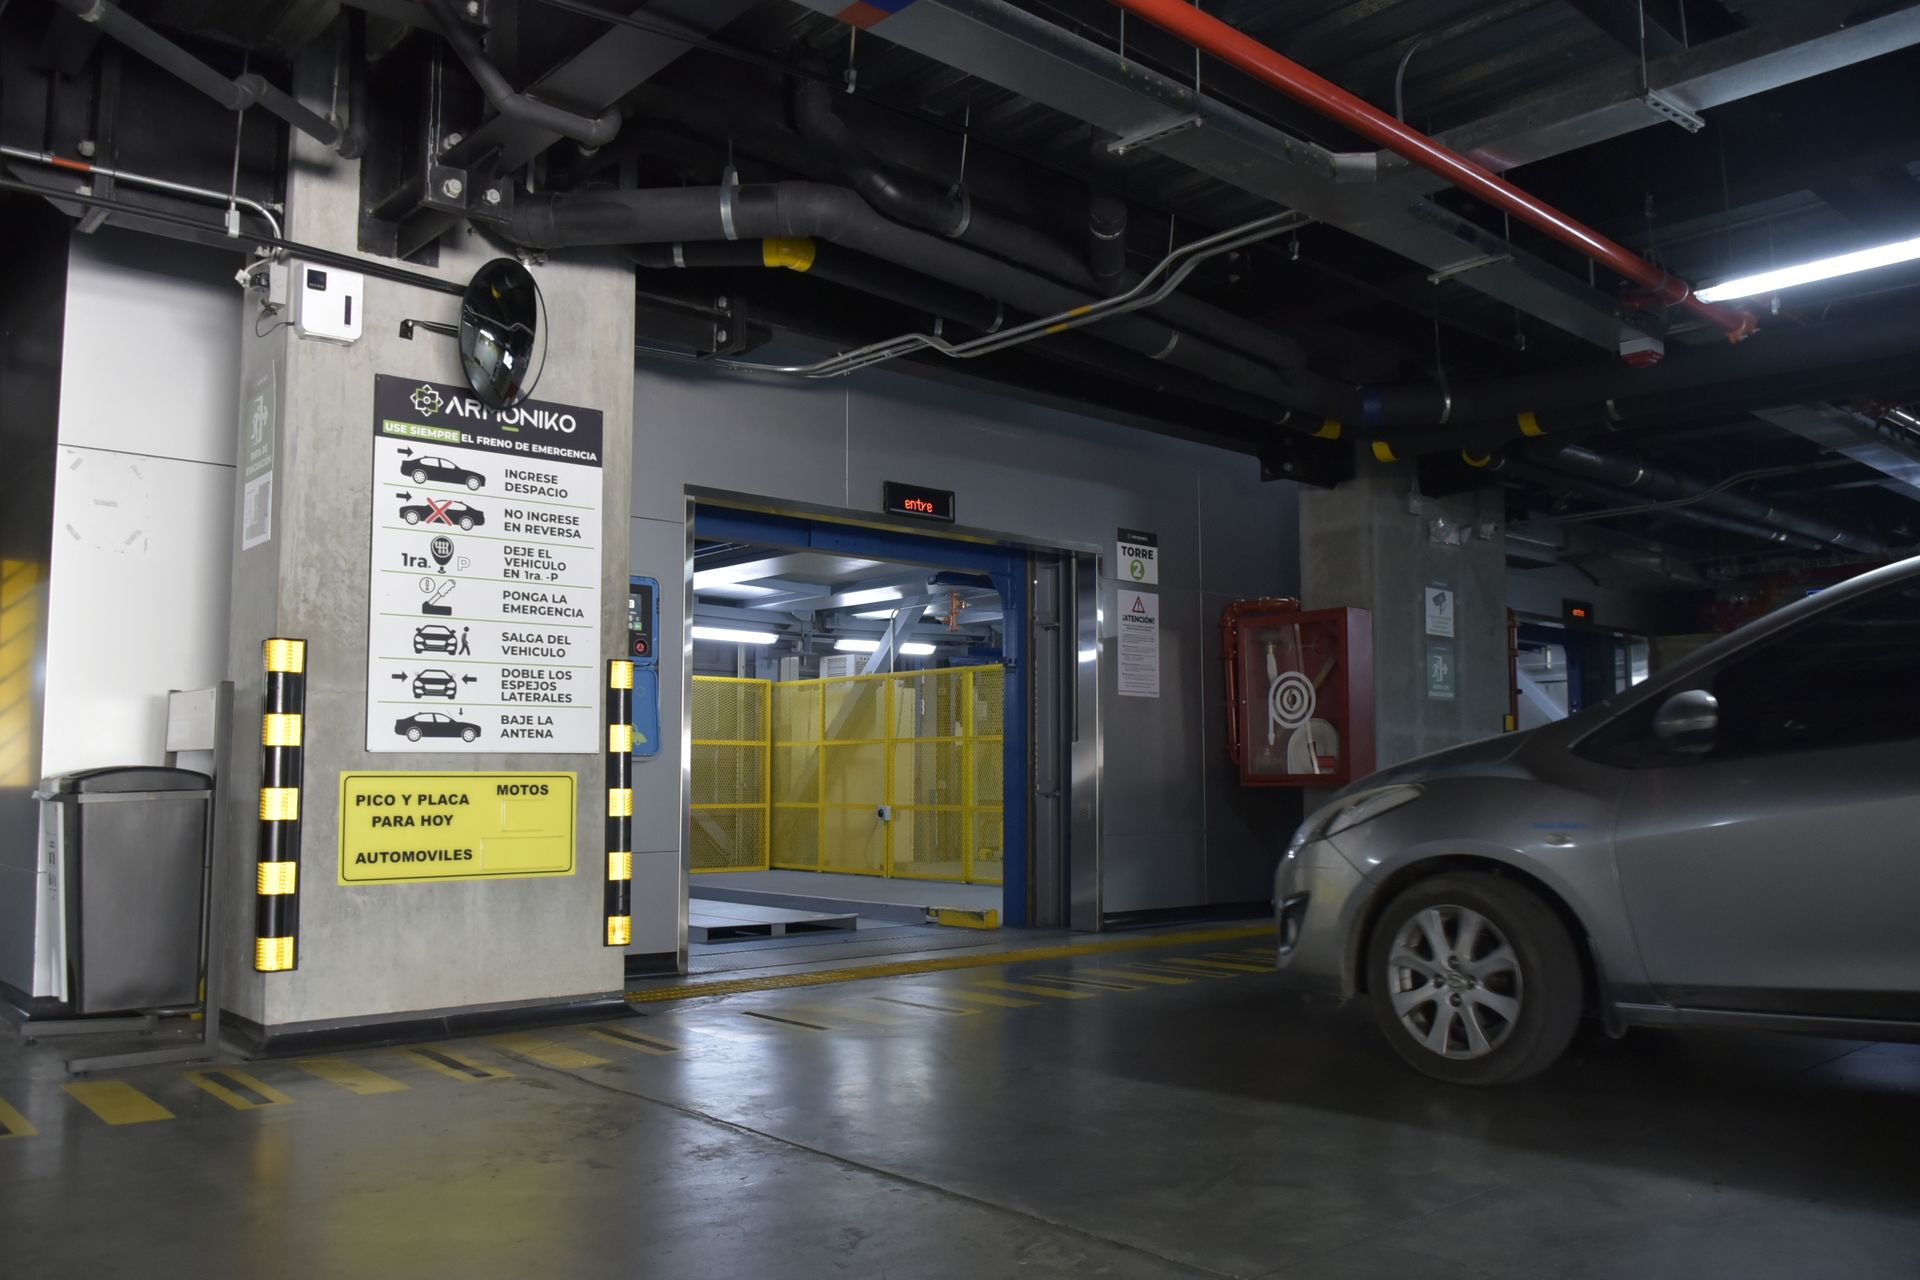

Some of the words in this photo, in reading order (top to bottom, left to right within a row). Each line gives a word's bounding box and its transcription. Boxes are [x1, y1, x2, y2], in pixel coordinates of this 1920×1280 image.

[385, 423, 407, 433] USE
[410, 427, 458, 441] SIEMPRE
[462, 434, 474, 443] EL
[476, 436, 512, 448] FRENO
[515, 442, 529, 451] DE
[531, 444, 597, 461] EMERGENCIA
[505, 469, 558, 484] INGRESE
[504, 483, 568, 498] DESPACIO
[904, 499, 933, 512] entre
[504, 509, 523, 520] NO
[527, 511, 580, 526] INGRESE
[504, 522, 522, 532] EN
[525, 524, 581, 539] REVERSA
[504, 546, 534, 557] DEJE
[538, 548, 552, 558] EL
[1121, 546, 1154, 560] TORRE
[402, 553, 431, 569] 1ra.
[457, 557, 470, 571] P
[504, 557, 566, 571] VEHICULO
[504, 569, 520, 579] EN
[524, 570, 543, 581] 1ra.
[503, 590, 549, 603] PONGA
[552, 594, 567, 604] LA
[503, 604, 584, 618] EMERGENCIA
[502, 632, 544, 644] SALGA
[547, 635, 571, 645] DEL
[502, 646, 566, 658] VEHICULO
[501, 669, 544, 679] DOBLE
[549, 670, 572, 680] LOS
[501, 680, 556, 692] ESPEJOS
[501, 692, 572, 703] LATERALES
[501, 715, 533, 725] BAJE
[538, 716, 553, 725] LA
[500, 728, 553, 738] ANTENA
[497, 784, 549, 796] MOTOS
[356, 794, 395, 806] PICO
[402, 794, 412, 805] Y
[417, 794, 470, 806] PLACA
[372, 816, 415, 827] PARA
[421, 814, 454, 826] HOY
[355, 849, 473, 864] AUTOMOVILES
